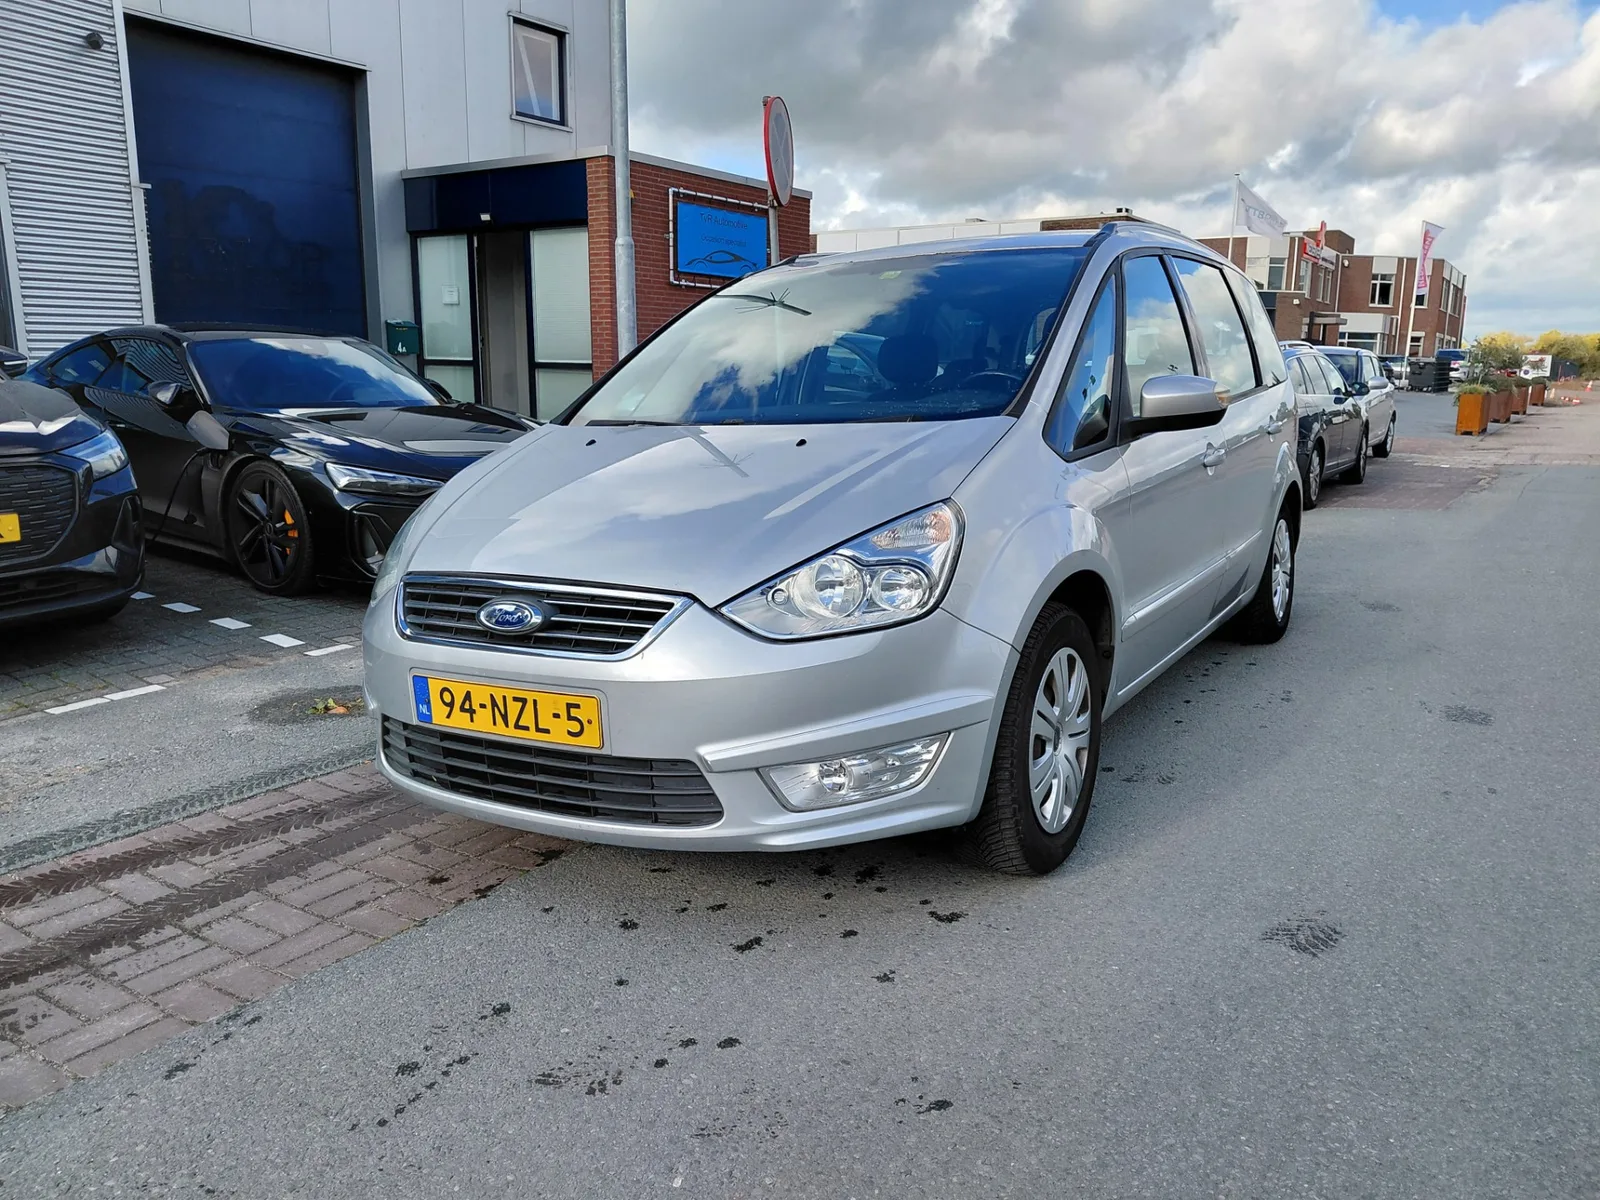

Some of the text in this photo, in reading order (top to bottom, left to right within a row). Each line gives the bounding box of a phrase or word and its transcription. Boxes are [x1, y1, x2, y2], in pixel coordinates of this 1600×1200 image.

[491, 607, 523, 623] Ford
[419, 703, 431, 715] NL
[439, 686, 585, 738] 94-NZL-5
